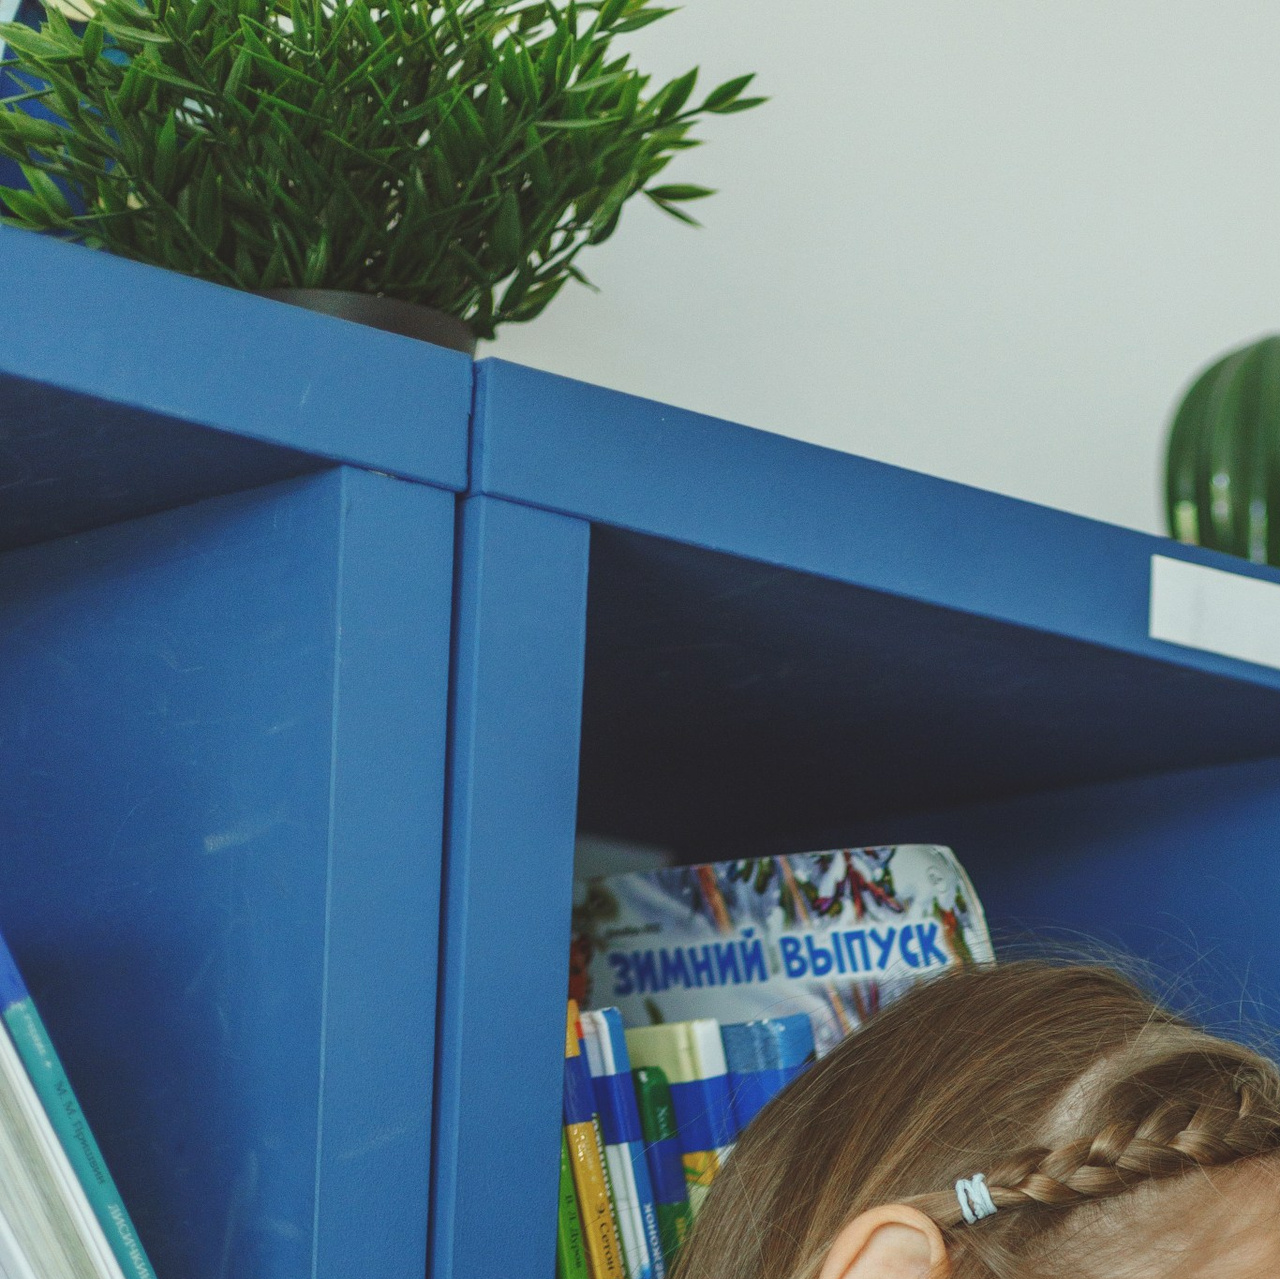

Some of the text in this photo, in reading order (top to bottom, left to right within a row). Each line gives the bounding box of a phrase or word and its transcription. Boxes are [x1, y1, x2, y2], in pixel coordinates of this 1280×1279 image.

[607, 921, 948, 996] ЗИМНИЙ ВЫПУСК
[71, 1119, 106, 1186] Пришвин
